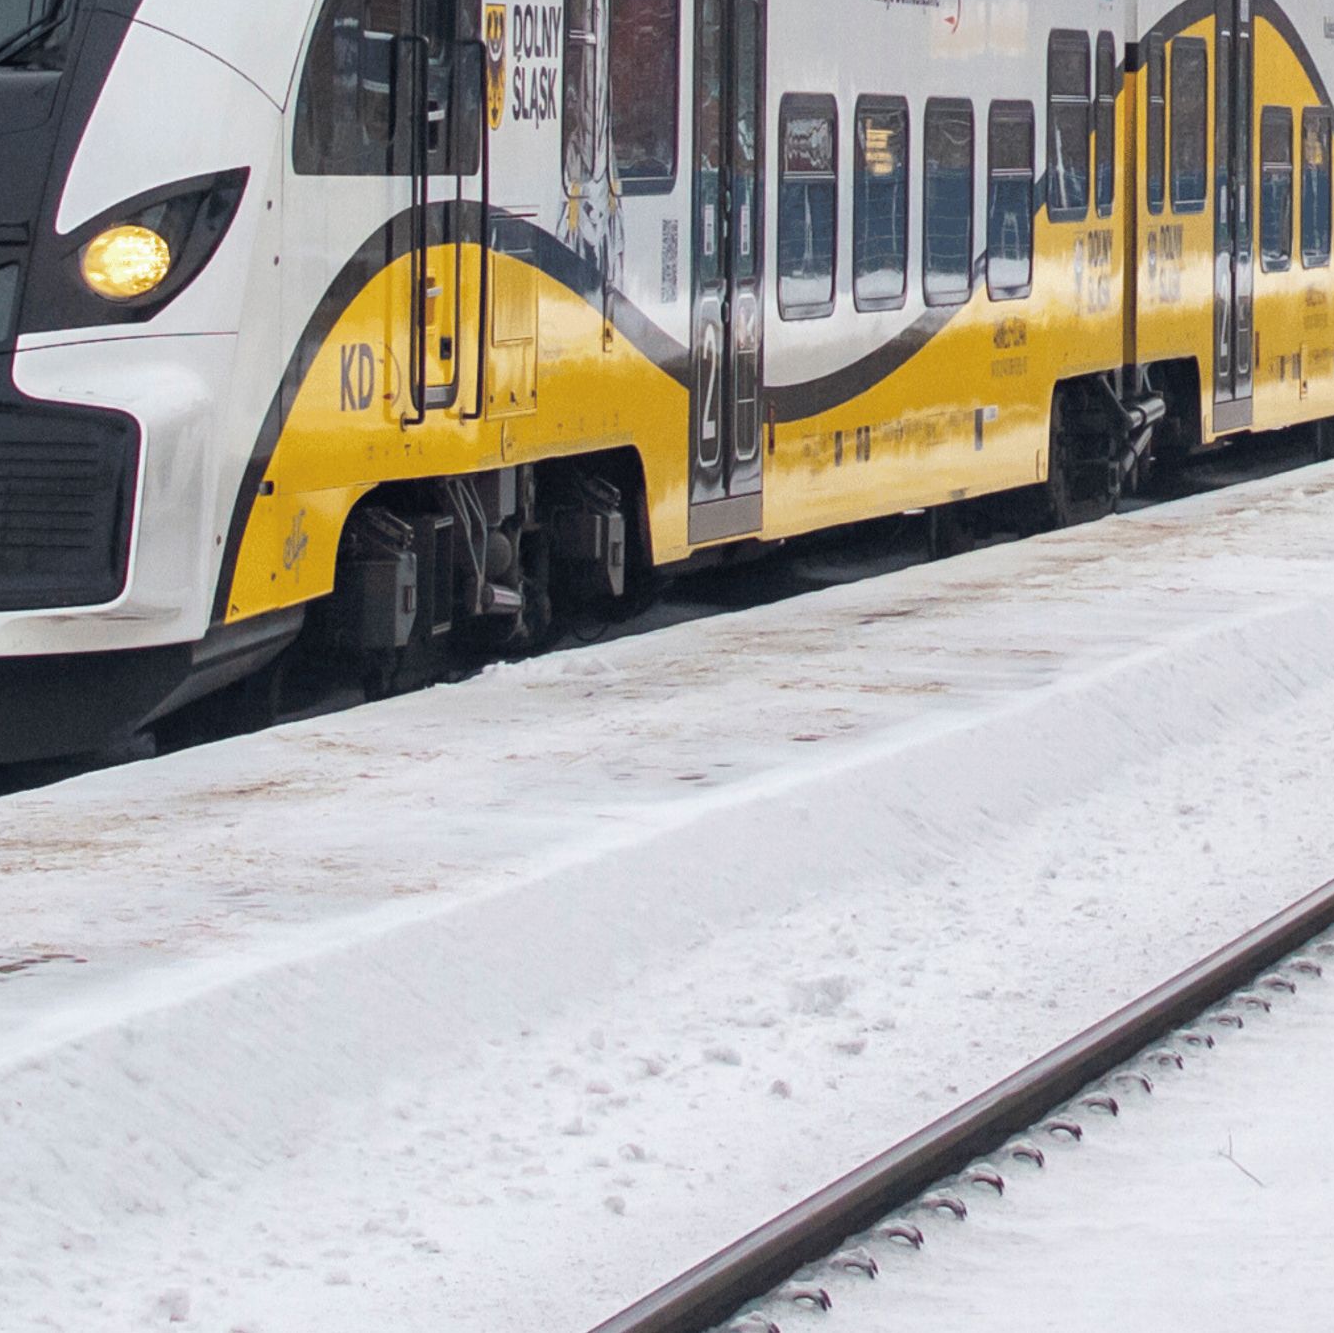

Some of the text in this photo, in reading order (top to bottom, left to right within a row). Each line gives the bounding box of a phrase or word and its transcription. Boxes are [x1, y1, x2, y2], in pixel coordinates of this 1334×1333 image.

[513, 4, 562, 58] DOLNY
[512, 56, 557, 130] ŚLĄSK
[341, 342, 375, 411] KD
[702, 323, 716, 441] 2
